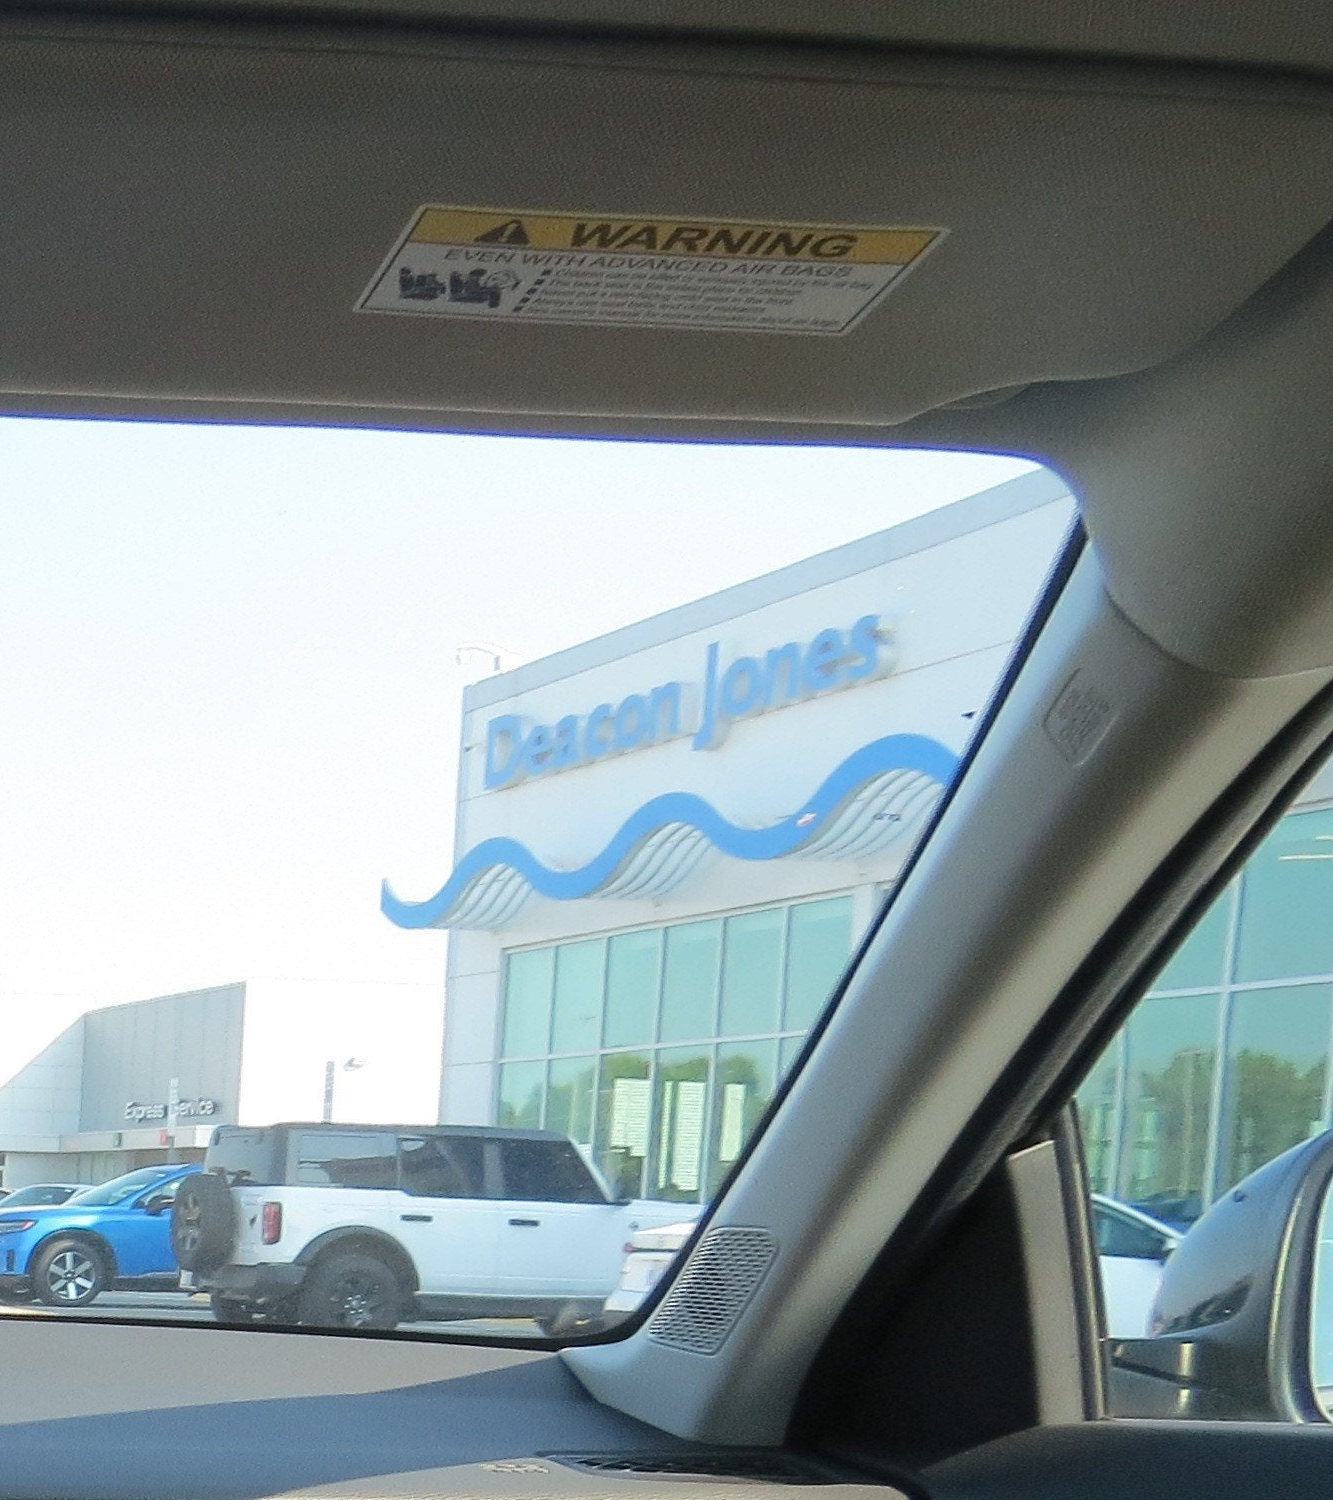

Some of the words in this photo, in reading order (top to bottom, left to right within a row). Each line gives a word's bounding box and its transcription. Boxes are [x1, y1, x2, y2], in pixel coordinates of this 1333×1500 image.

[568, 223, 861, 259] WARNING
[445, 250, 515, 264] EVEN
[522, 252, 586, 267] WITH
[589, 256, 728, 273] ADVANCED
[732, 262, 776, 275] AIR
[781, 264, 853, 278] BAGS
[484, 680, 682, 790] Deacon
[693, 614, 882, 752] Jones
